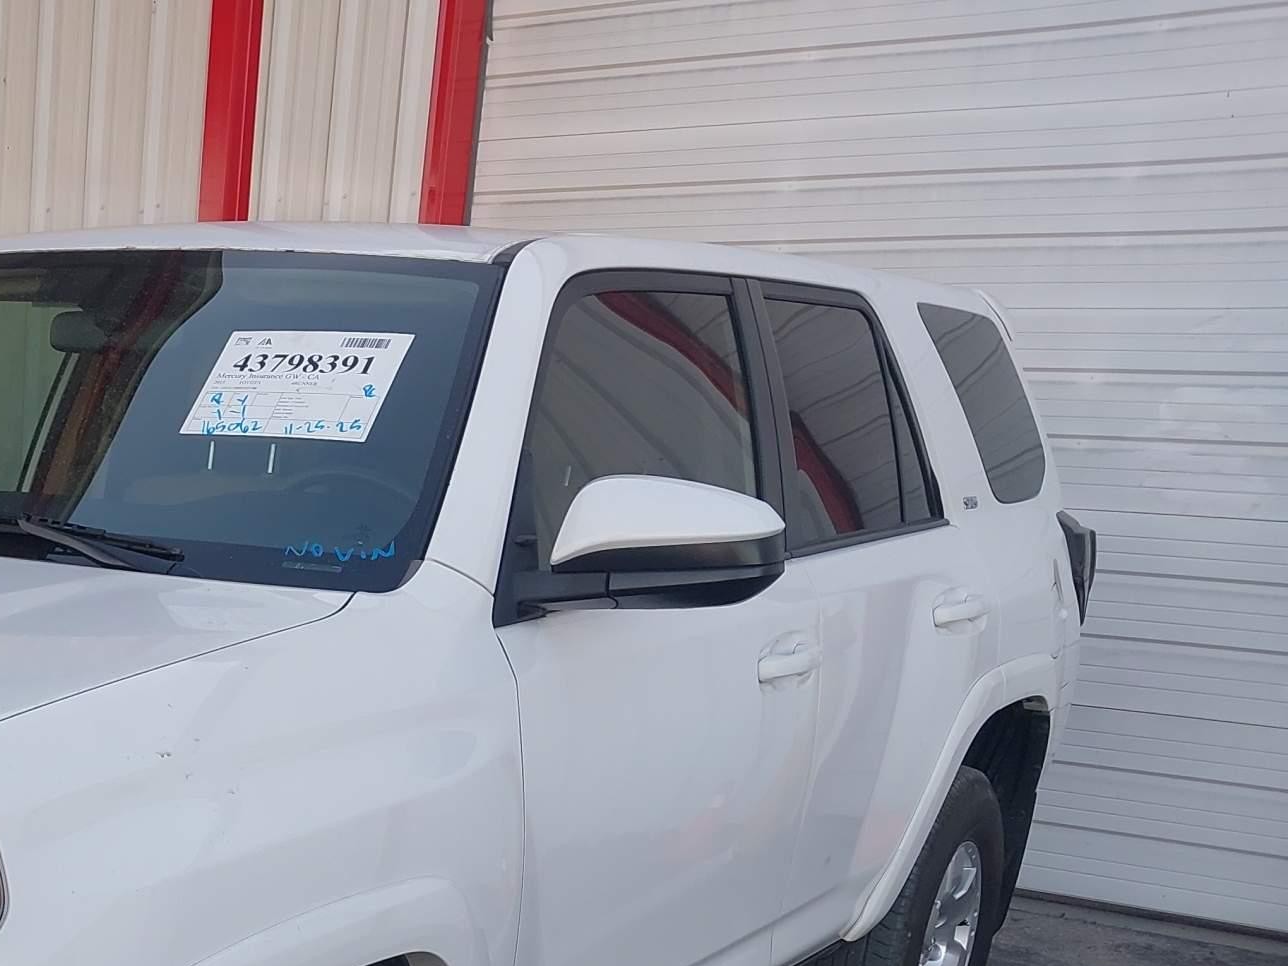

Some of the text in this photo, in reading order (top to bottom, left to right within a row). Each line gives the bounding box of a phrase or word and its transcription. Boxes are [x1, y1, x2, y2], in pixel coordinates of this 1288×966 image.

[232, 352, 376, 376] 43798391
[216, 373, 247, 381] Mercury
[307, 373, 320, 381] CA
